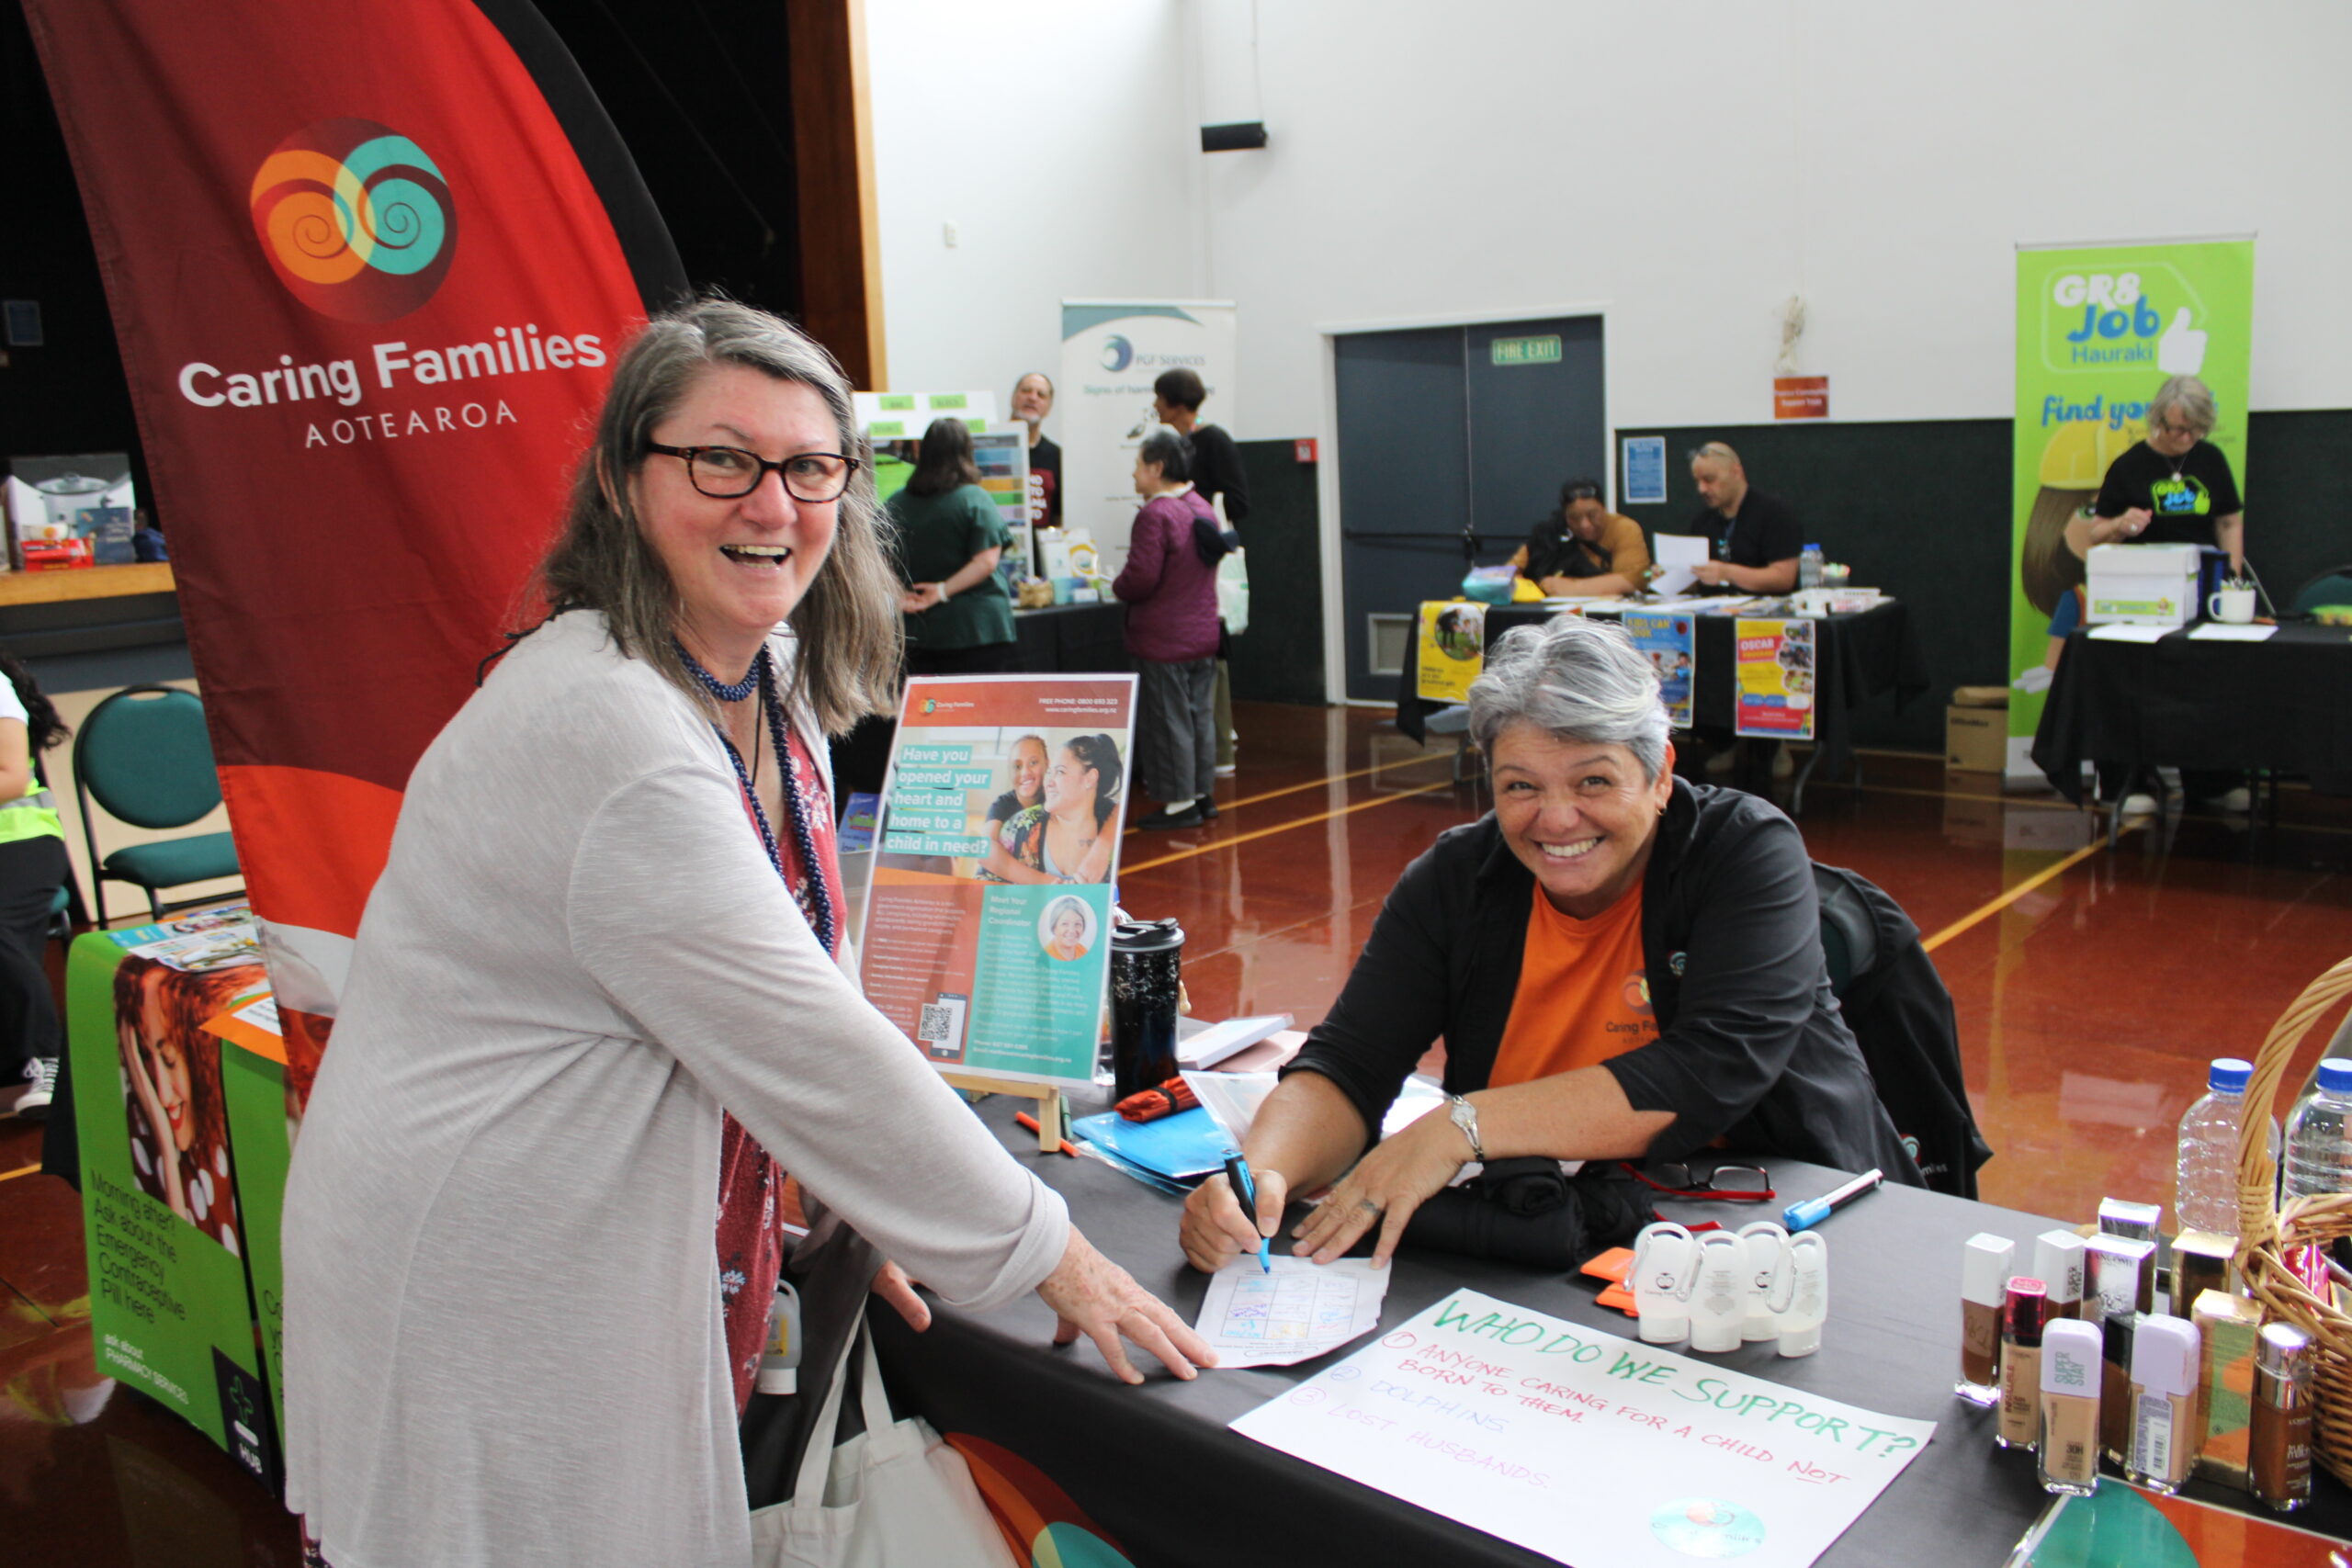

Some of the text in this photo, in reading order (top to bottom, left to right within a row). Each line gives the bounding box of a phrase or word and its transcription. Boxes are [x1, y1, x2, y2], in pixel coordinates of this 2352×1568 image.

[2053, 272, 2141, 311] GR8
[2066, 295, 2161, 344] Job
[178, 323, 606, 407] Caring Families
[1498, 339, 1555, 360] FIRE EXIT
[2072, 341, 2154, 364] Hauraki
[304, 399, 517, 449] AOTEAROA
[2041, 394, 2103, 428] find
[1740, 638, 1774, 650] OSCAR
[902, 747, 968, 764] Have you
[898, 770, 989, 786] opened your
[894, 790, 964, 807] heart and
[889, 813, 963, 829] home to a
[887, 835, 989, 854] child in need?
[989, 906, 1022, 916] Regional
[990, 896, 1027, 905] Meet Your
[988, 917, 1032, 927] Coordinator
[1606, 1021, 1639, 1034] Caring
[91, 1168, 176, 1236] Morning after?
[96, 1197, 176, 1263] Ask about the
[96, 1224, 164, 1286] Emergency
[99, 1251, 186, 1321] Contraceptive
[101, 1278, 154, 1324] Pill here
[104, 1334, 144, 1360] ask about
[106, 1347, 189, 1405] PHARMACY SERVICES
[1433, 1300, 1917, 1457] WHO DO WE SUPPORT?
[2054, 1351, 2070, 1384] SUPER
[2069, 1360, 2085, 1386] STAY
[1396, 1358, 1585, 1424] BORN TO THEM.
[1416, 1343, 1515, 1381] ANYONE
[1520, 1377, 1610, 1413] CARING
[1615, 1405, 1668, 1431] FOR
[1673, 1425, 1693, 1439] A
[1701, 1433, 1774, 1462] CHILD
[1786, 1460, 1851, 1484] NOT
[239, 1442, 263, 1474] HUB
[1327, 1403, 1399, 1433] LOST
[1405, 1429, 1553, 1489] HUSBANDS.
